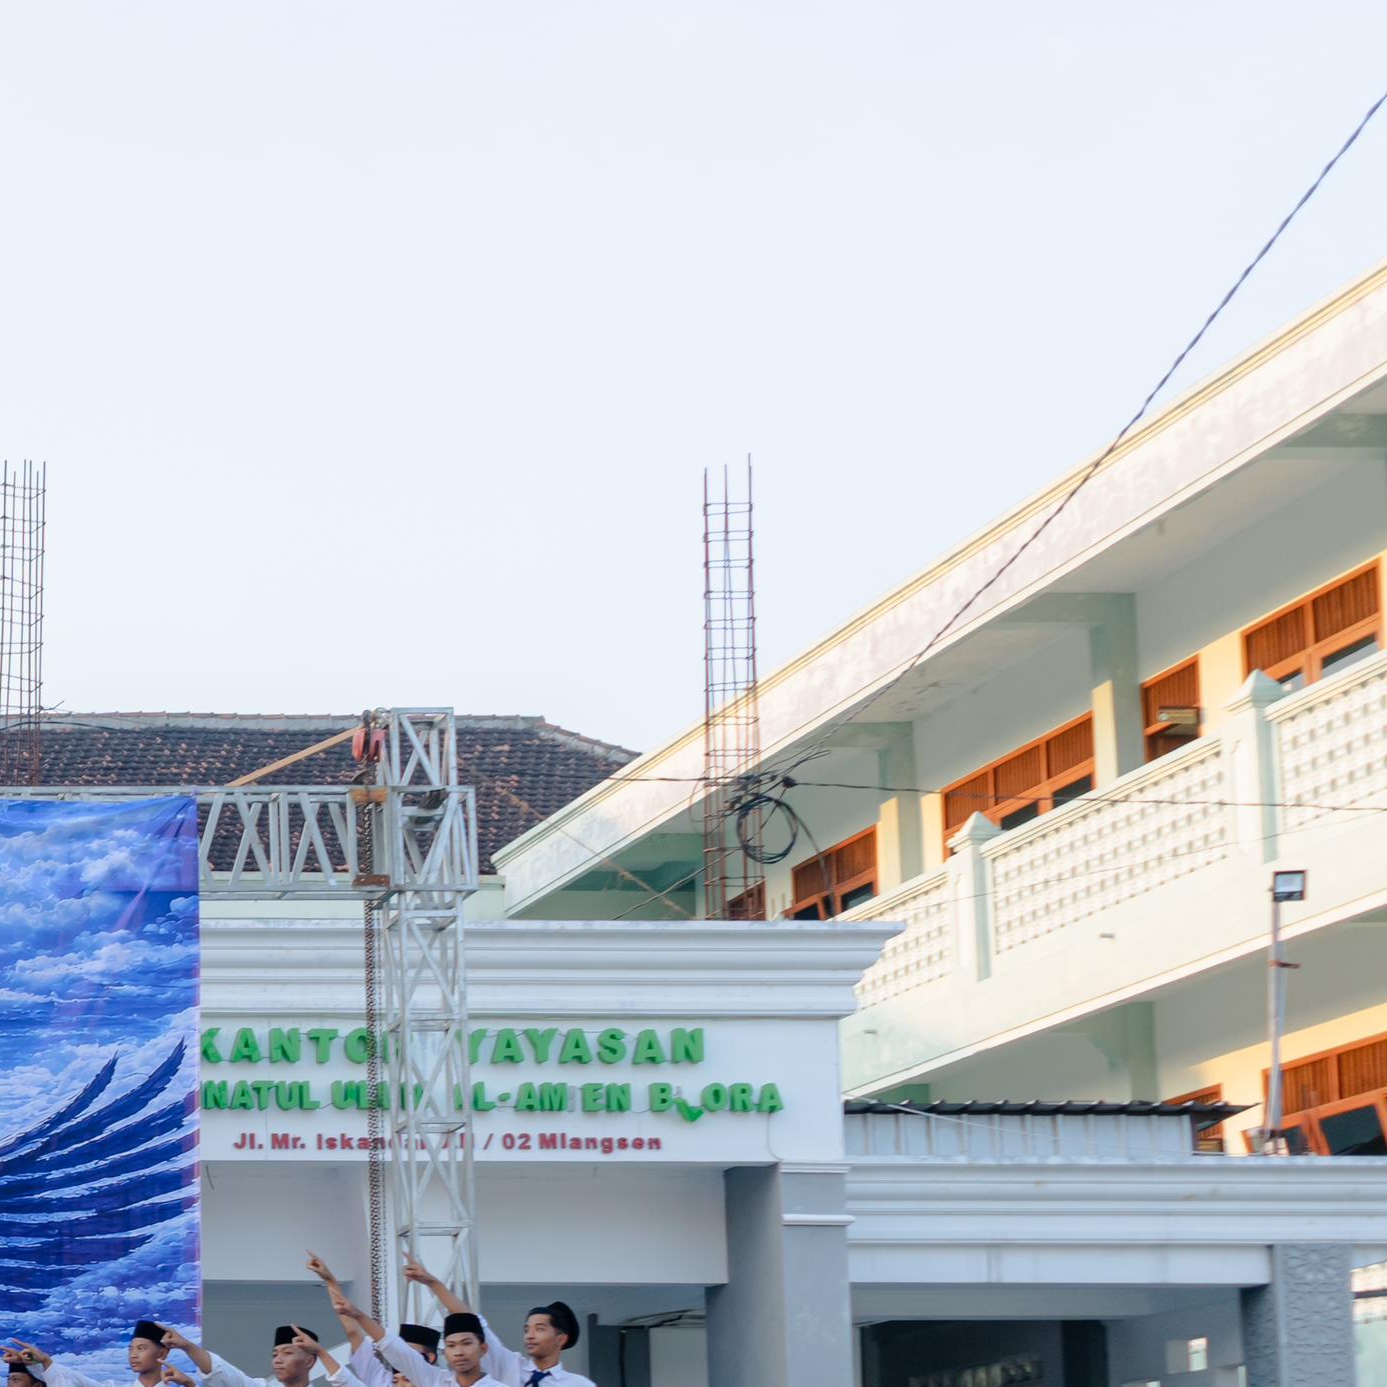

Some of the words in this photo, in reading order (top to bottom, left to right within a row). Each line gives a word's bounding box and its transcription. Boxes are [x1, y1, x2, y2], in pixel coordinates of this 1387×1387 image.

[234, 1132, 263, 1151] Jl.
[271, 1132, 305, 1151] Mr.
[502, 1132, 531, 1151] 02
